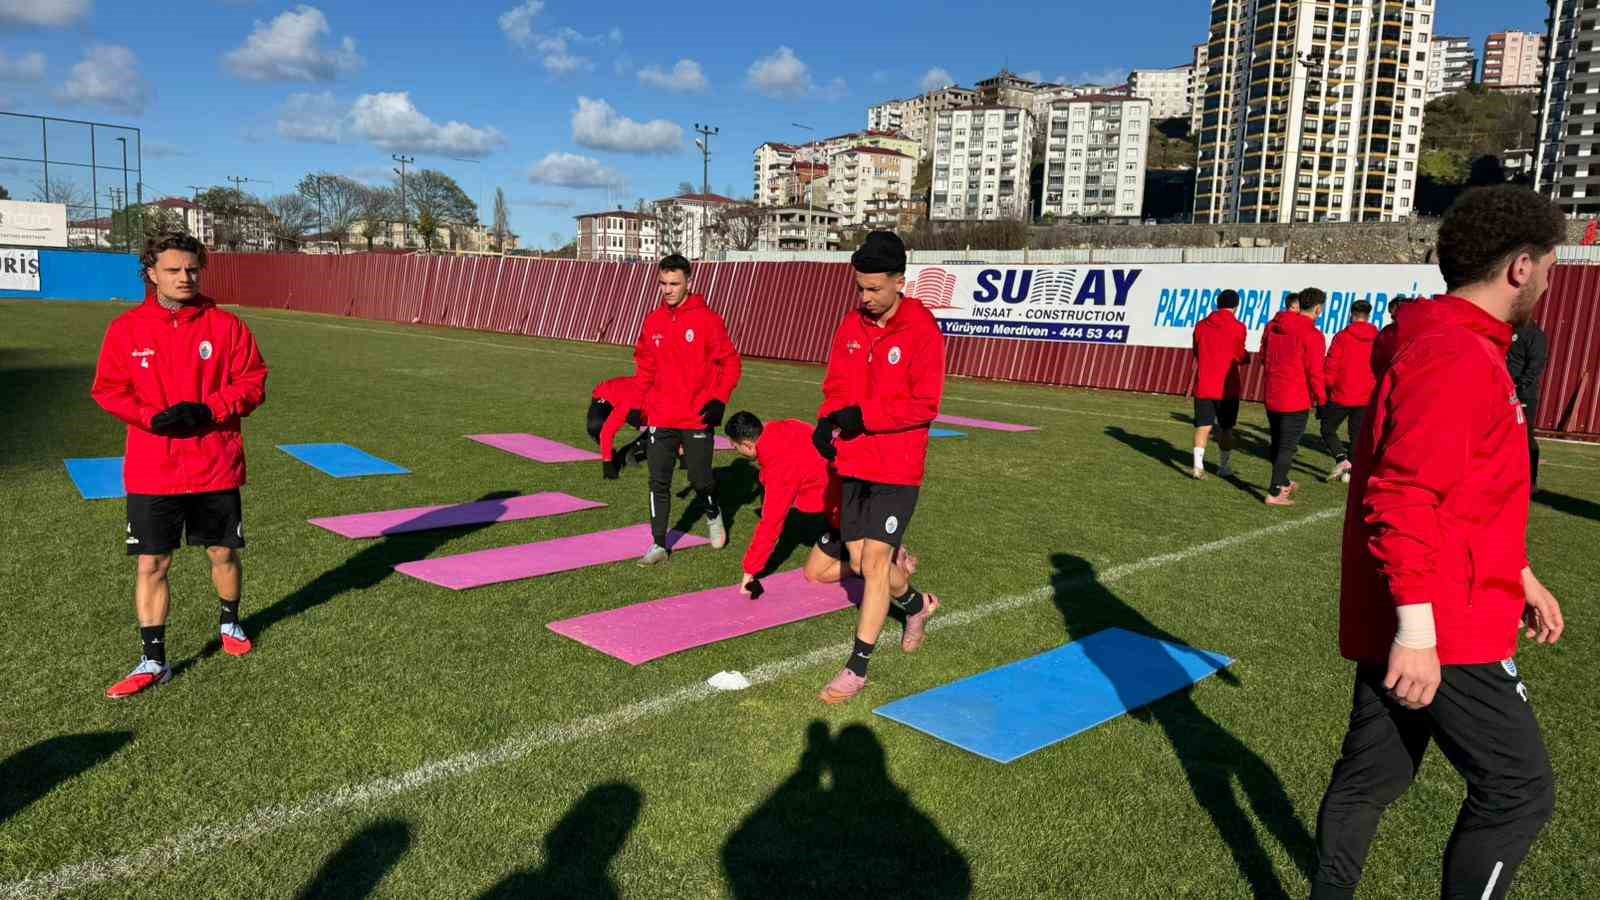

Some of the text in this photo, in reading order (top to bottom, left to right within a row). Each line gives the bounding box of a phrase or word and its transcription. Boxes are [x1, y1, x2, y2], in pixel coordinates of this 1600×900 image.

[0, 253, 38, 278] RİŞ
[972, 307, 1013, 319] İNŞAAT
[1026, 309, 1126, 322] CONSTRUCTION
[945, 321, 990, 335] Yürüyen
[993, 324, 1049, 337] Merdiven
[1059, 327, 1083, 338] 444
[1086, 328, 1103, 339] 53
[1105, 329, 1123, 340] 44
